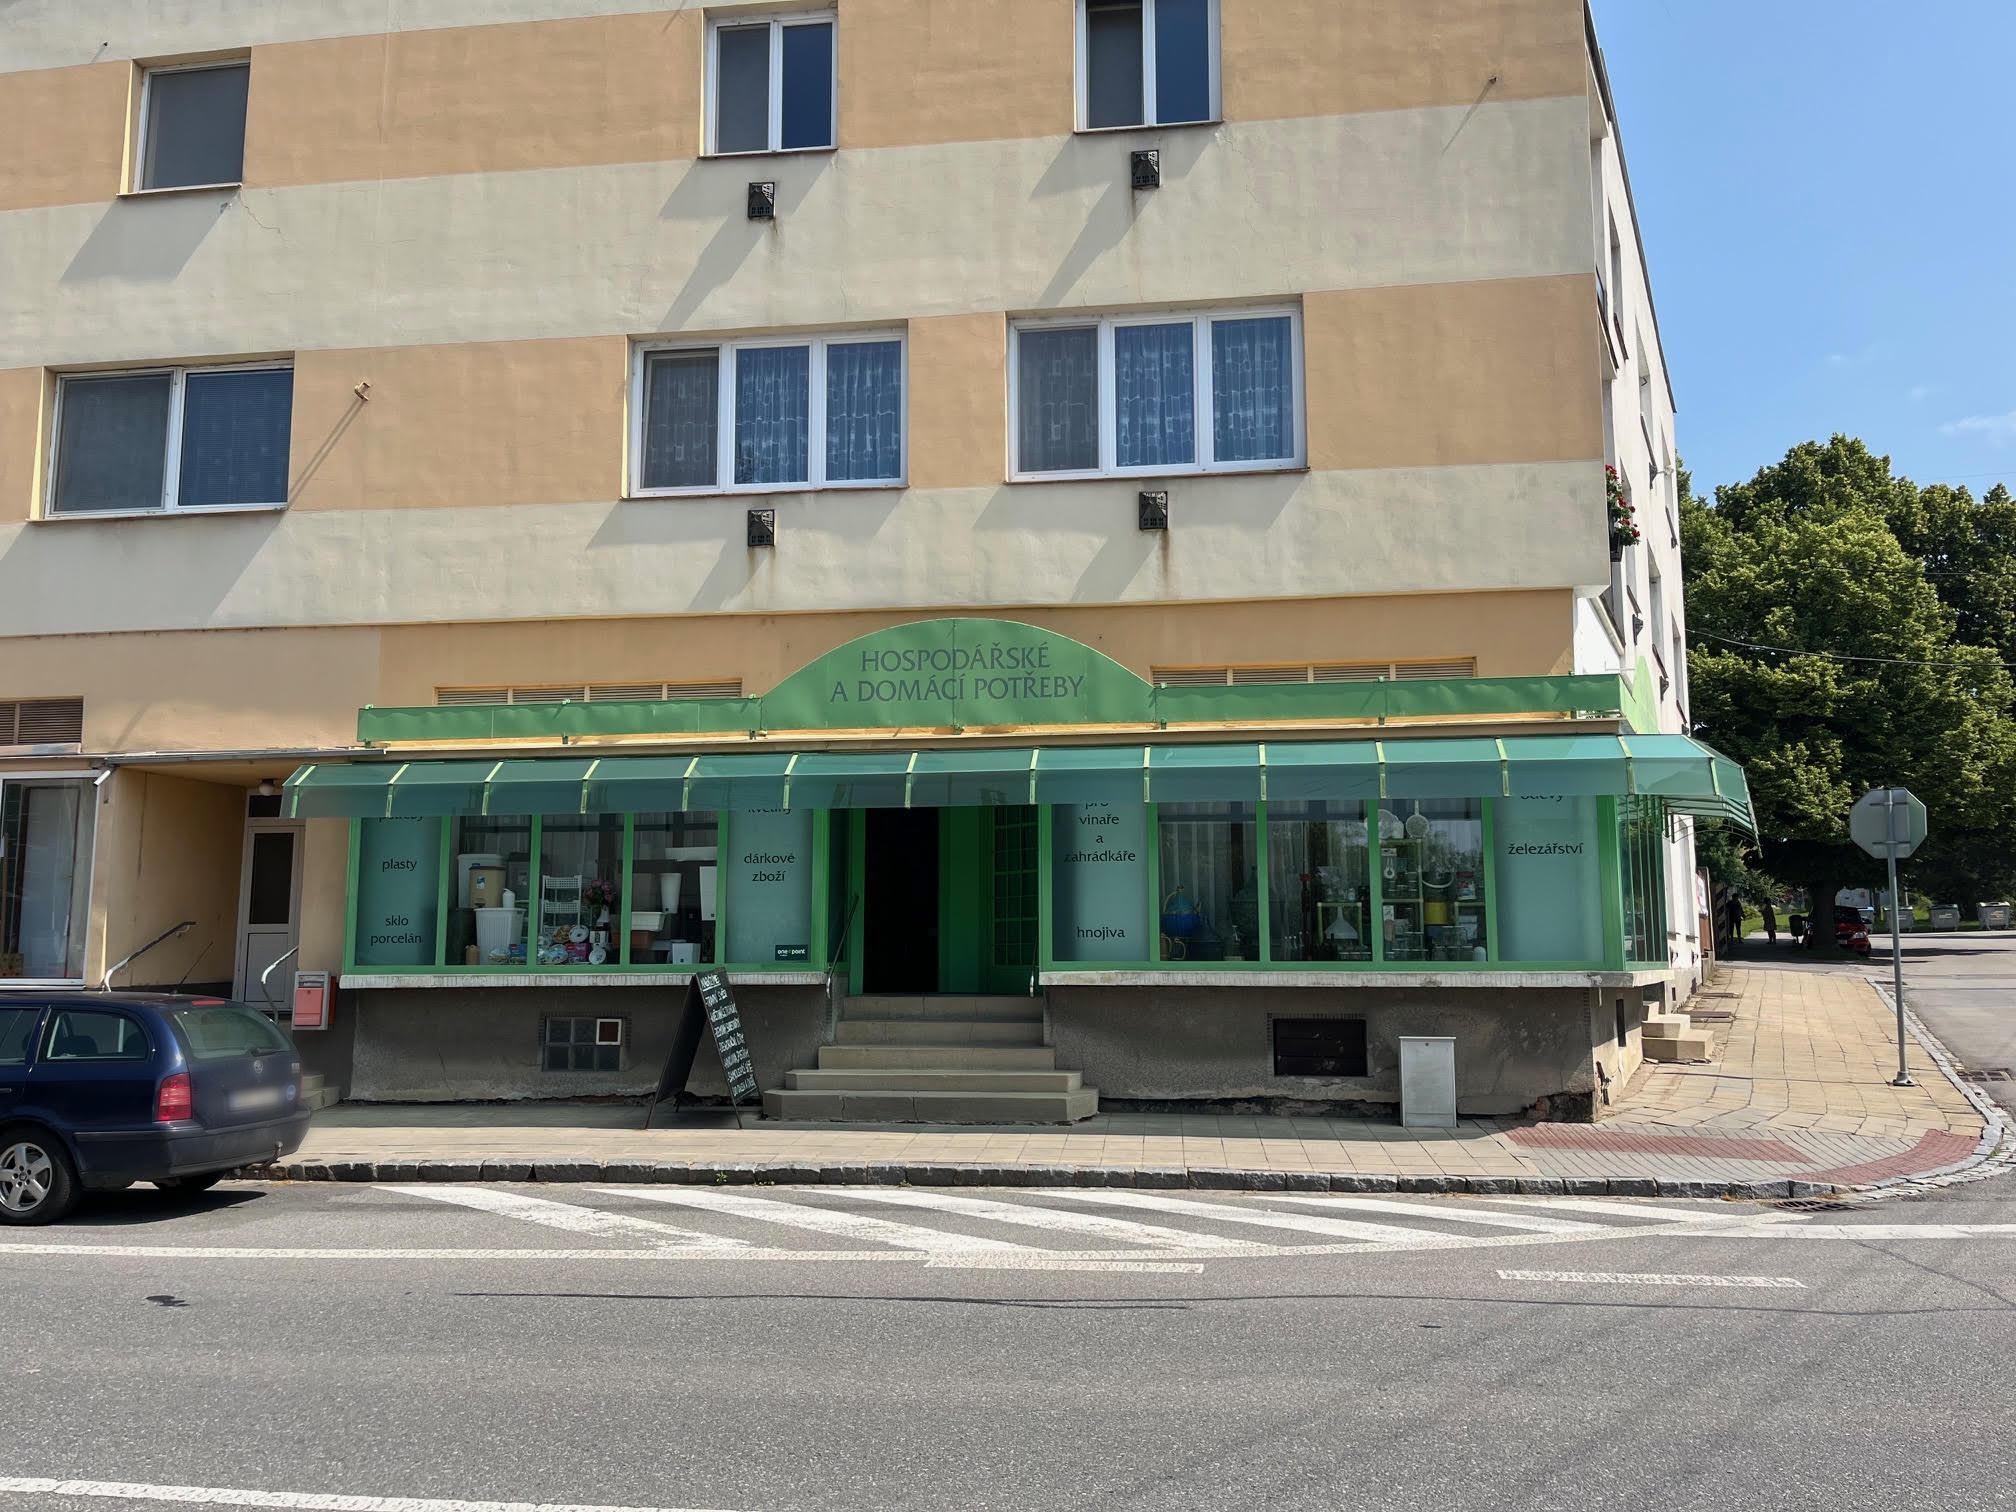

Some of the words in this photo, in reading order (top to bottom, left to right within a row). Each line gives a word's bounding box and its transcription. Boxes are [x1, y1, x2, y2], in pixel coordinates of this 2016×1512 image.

[861, 642, 1051, 672] HOSPODÁŘSKÉ
[830, 681, 849, 703] A
[858, 674, 965, 702] DOMÁCÍ
[974, 671, 1085, 701] POTŘEBY
[1079, 813, 1120, 825] vinaře
[1096, 835, 1105, 844] a
[1508, 843, 1584, 855] železářství
[744, 852, 796, 864] dárkové
[1064, 850, 1136, 862] zahrádkáře
[382, 858, 417, 872] plasty
[752, 871, 787, 882] zboží
[385, 915, 409, 926] sklo
[1077, 926, 1126, 940] hnojiva
[370, 933, 422, 946] porcelán
